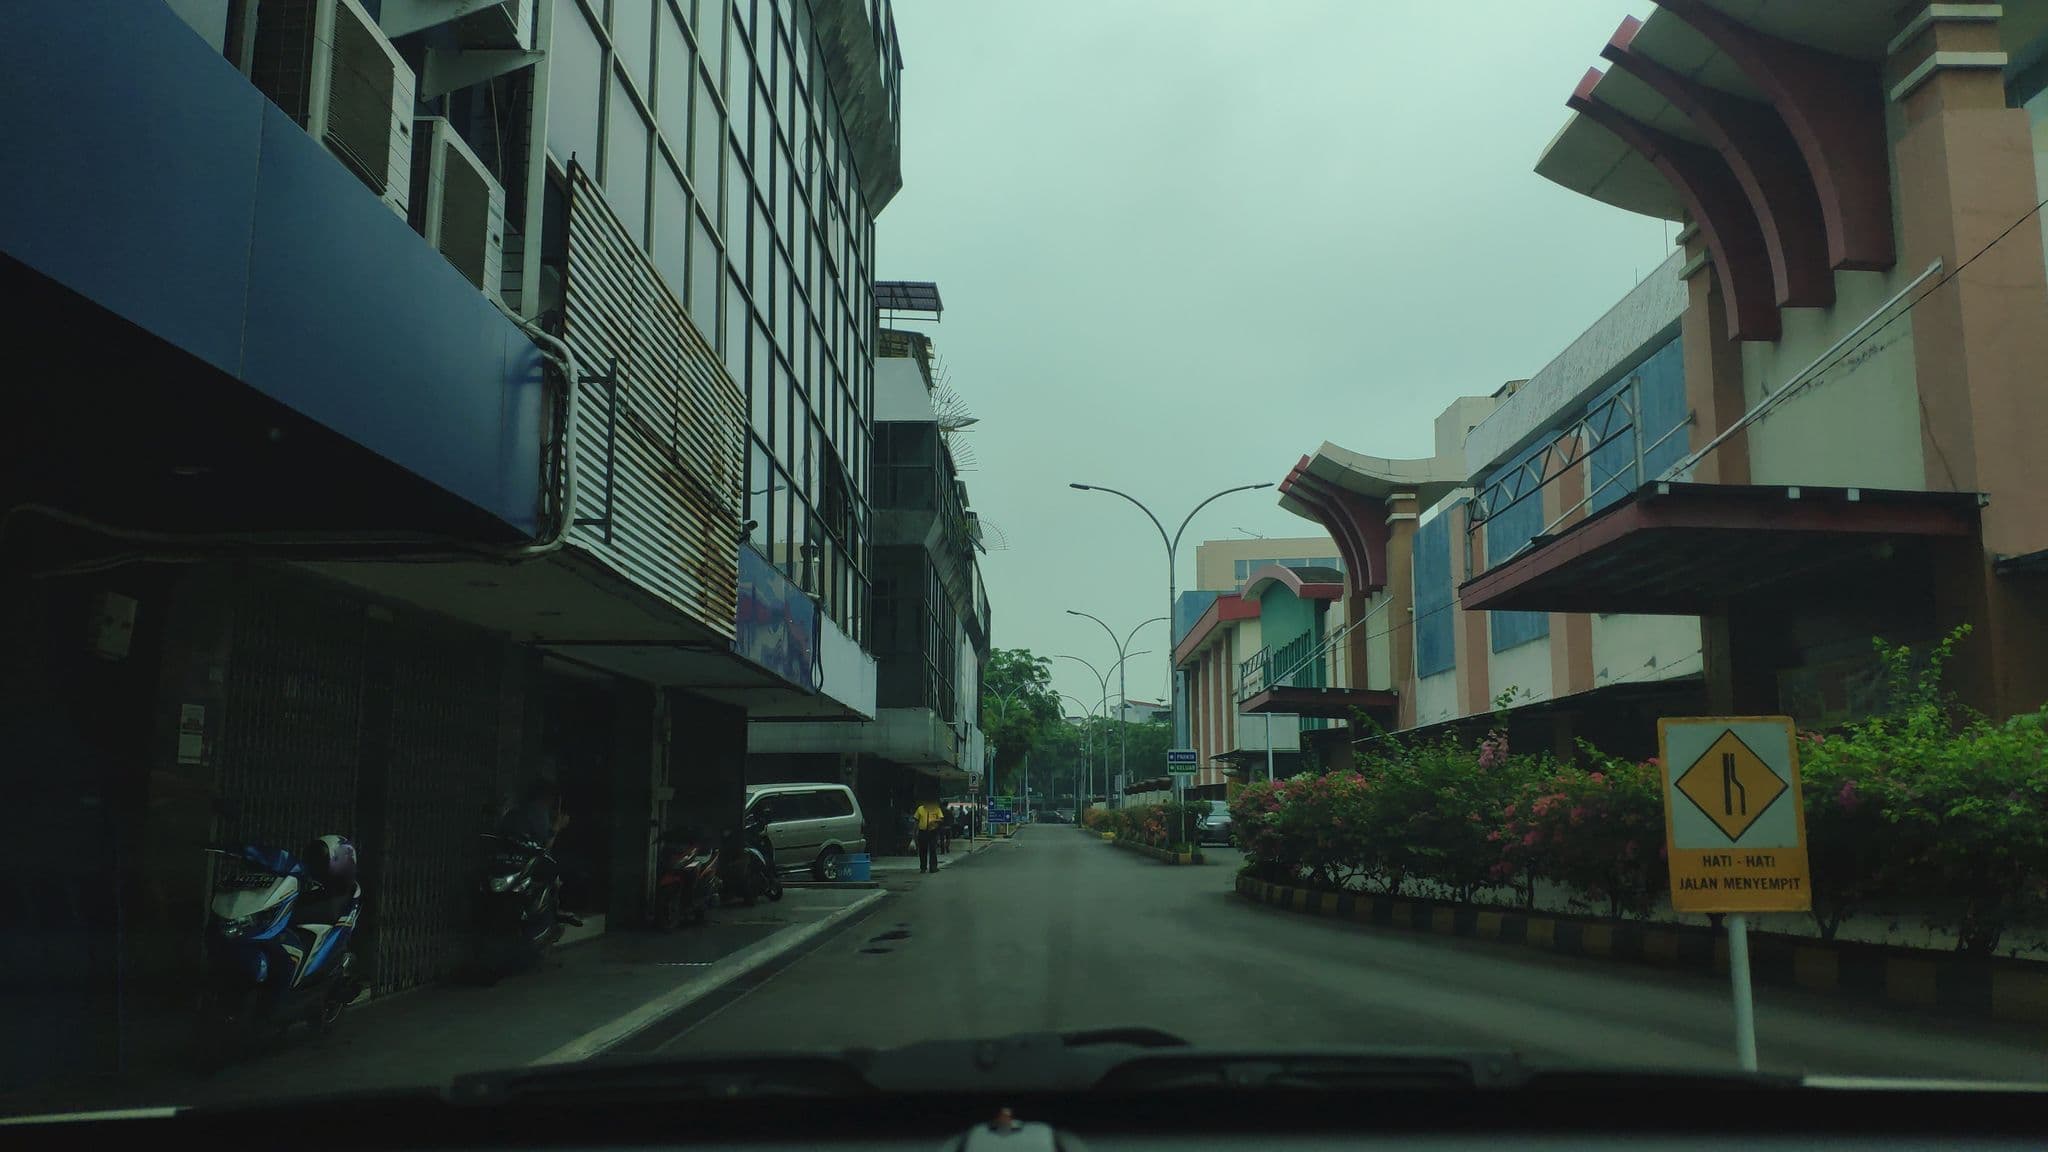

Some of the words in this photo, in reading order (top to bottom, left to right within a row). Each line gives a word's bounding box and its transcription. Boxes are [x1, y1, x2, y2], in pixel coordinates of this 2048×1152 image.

[1703, 855, 1732, 867] HATI
[1746, 855, 1775, 867] HATI
[1680, 877, 1717, 889] JALAN
[1724, 877, 1800, 889] MENYEMPIT
